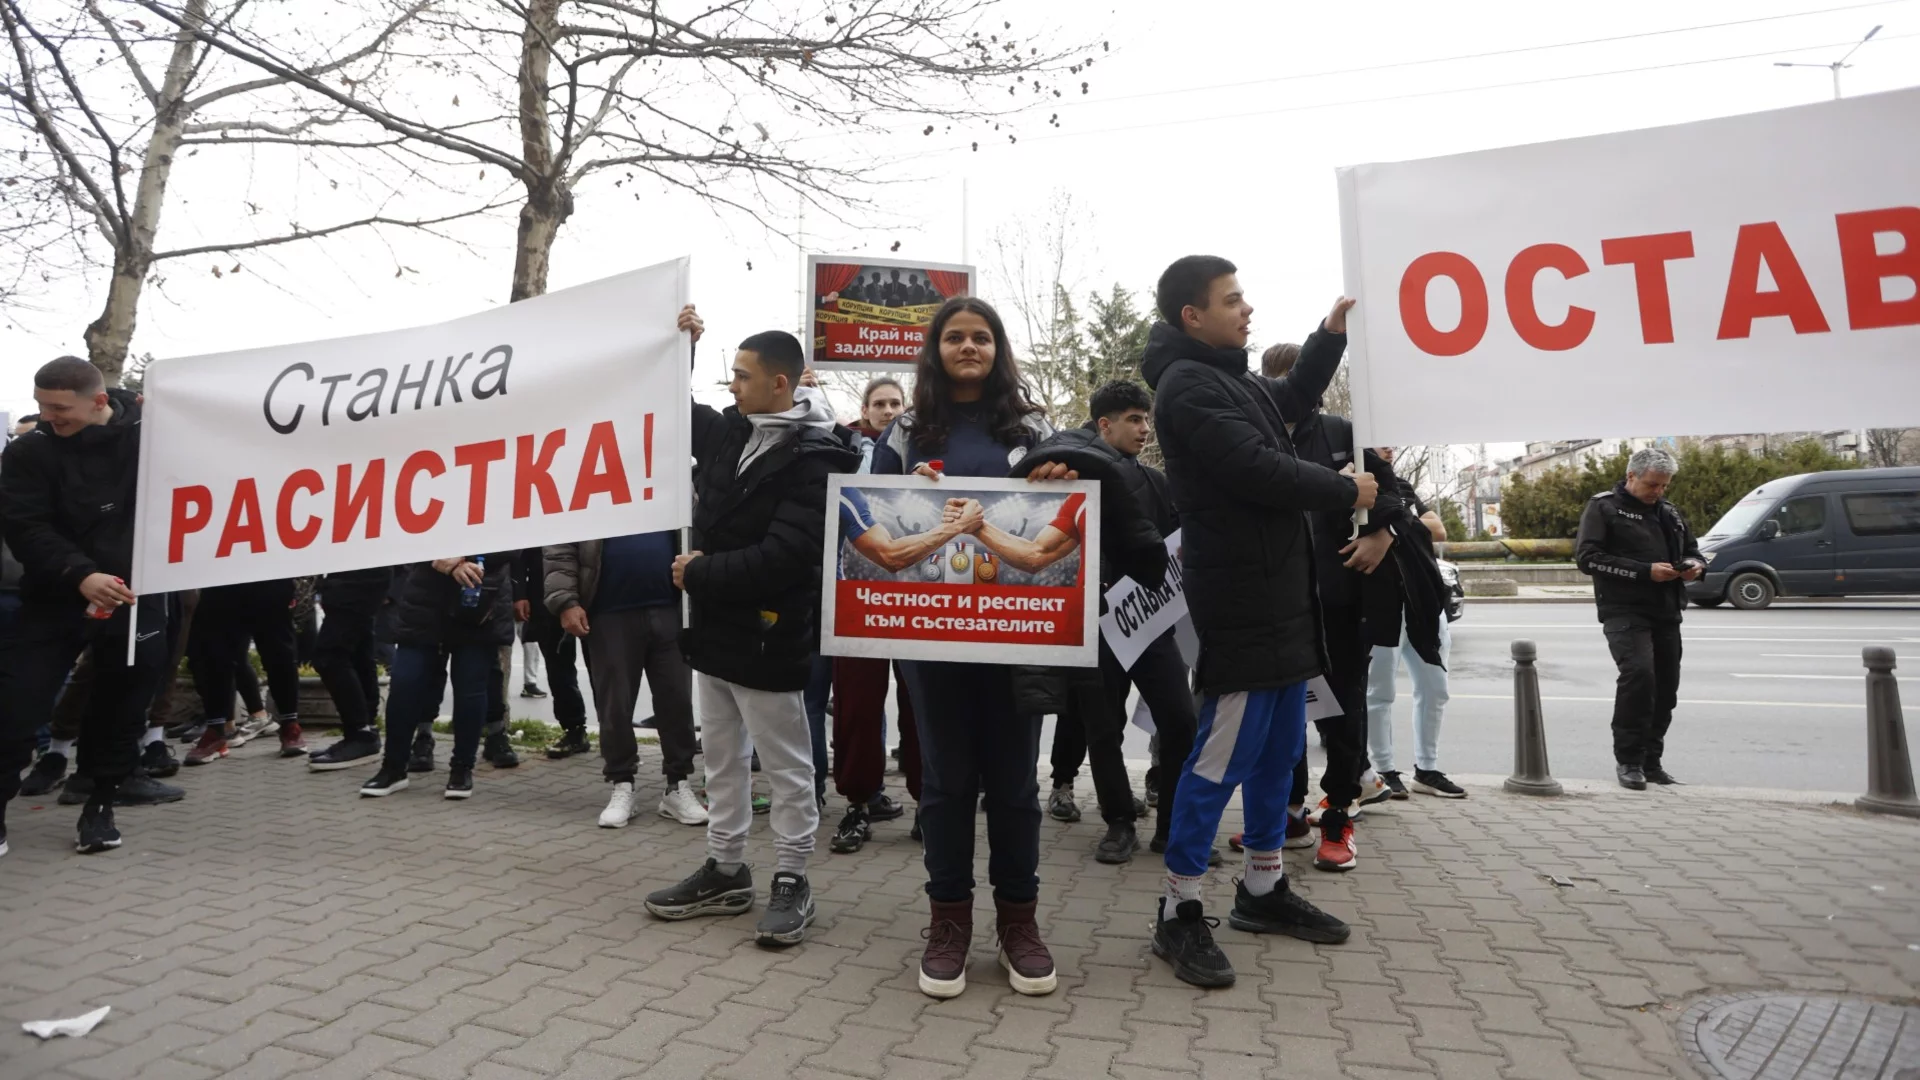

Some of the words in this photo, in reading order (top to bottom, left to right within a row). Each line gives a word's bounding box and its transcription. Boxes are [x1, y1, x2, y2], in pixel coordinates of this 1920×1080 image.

[1399, 206, 1920, 357] ОСТАВ
[859, 326, 899, 342] Край
[903, 331, 924, 341] на
[263, 344, 514, 434] Станка
[168, 413, 655, 564] РАСИСТКА!
[1588, 561, 1638, 579] POLICE
[855, 587, 952, 608] Честност
[958, 595, 972, 608] и
[977, 595, 1066, 613] респект
[864, 615, 905, 628] към
[911, 616, 1055, 633] състезателите
